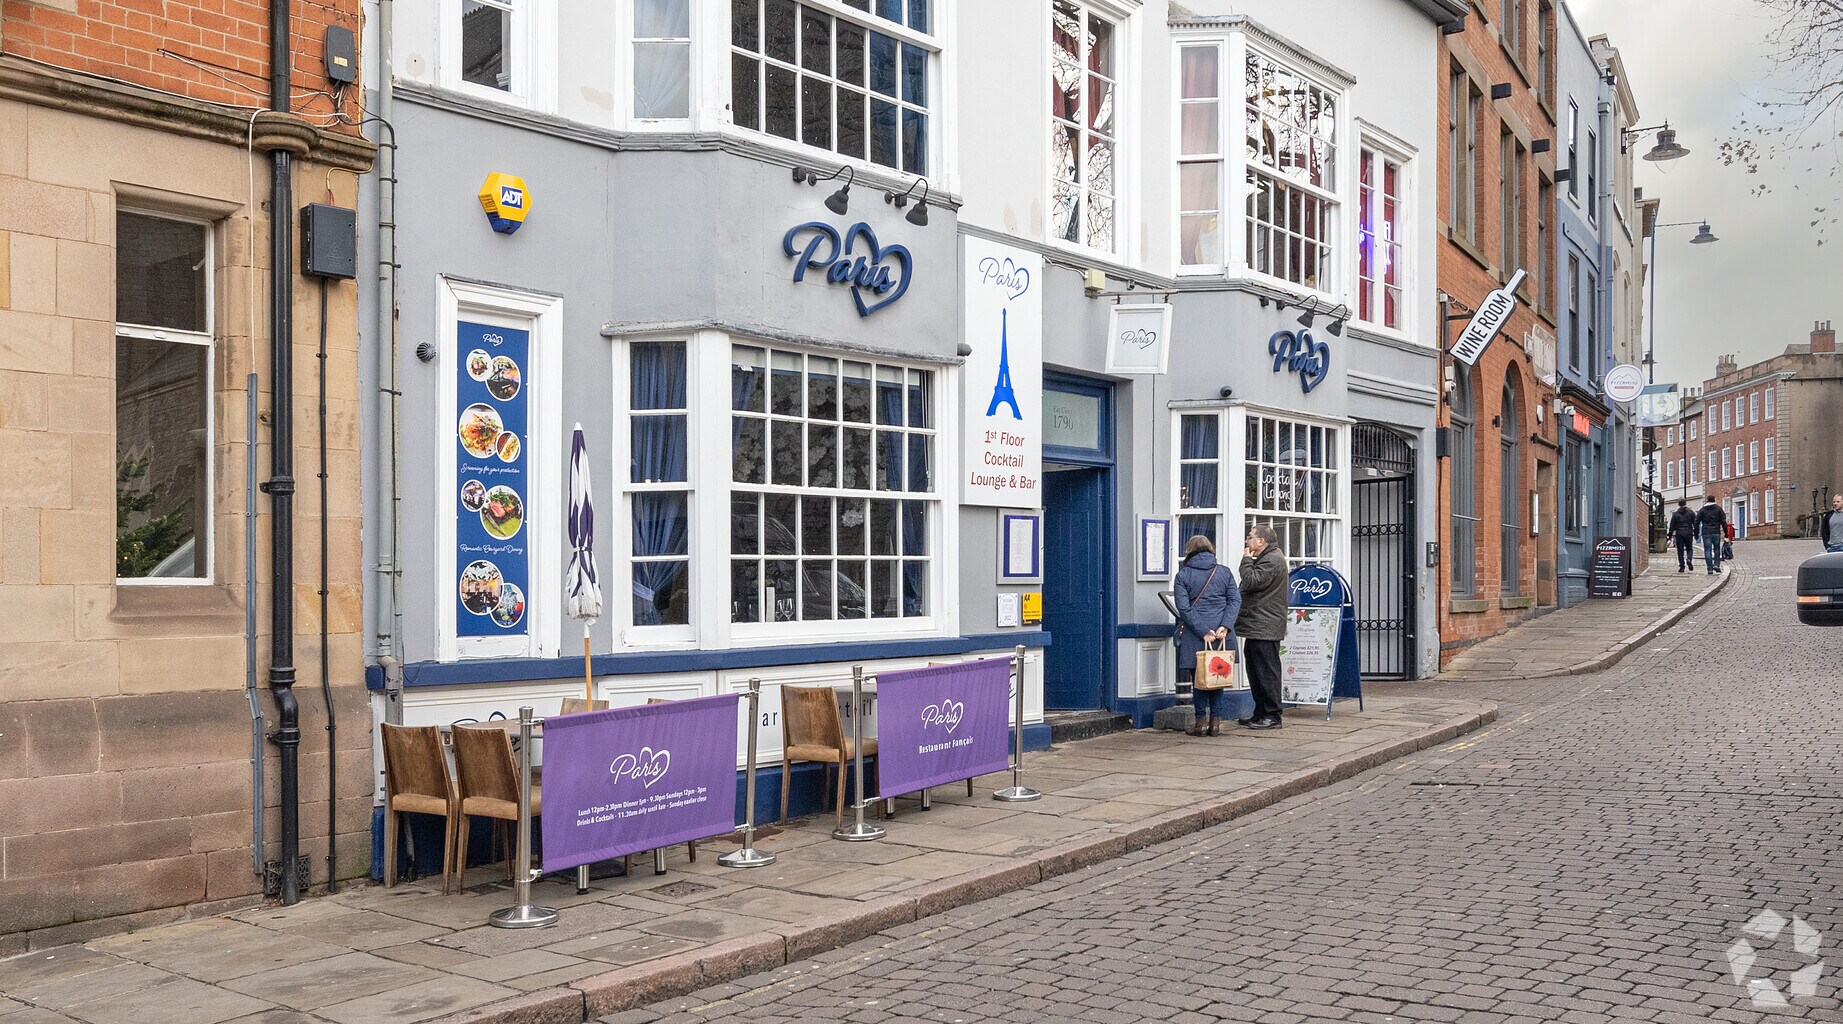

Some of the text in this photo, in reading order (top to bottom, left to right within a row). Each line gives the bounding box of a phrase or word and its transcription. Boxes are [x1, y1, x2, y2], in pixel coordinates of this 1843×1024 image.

[501, 189, 523, 206] ADT
[783, 221, 899, 296] Paris
[979, 257, 1025, 292] Paris
[1456, 293, 1511, 359] WINE ROOM
[483, 334, 501, 344] Paris
[1121, 330, 1153, 346] Paris
[1268, 330, 1324, 378] Paris
[984, 430, 1025, 447] 1st Floor
[984, 451, 1024, 467] Cocktail
[971, 472, 1037, 490] Lounge & Bar
[1291, 578, 1328, 595] Paris
[922, 703, 959, 729] Paris
[917, 741, 951, 754] Restaurant
[610, 752, 663, 785] Paris
